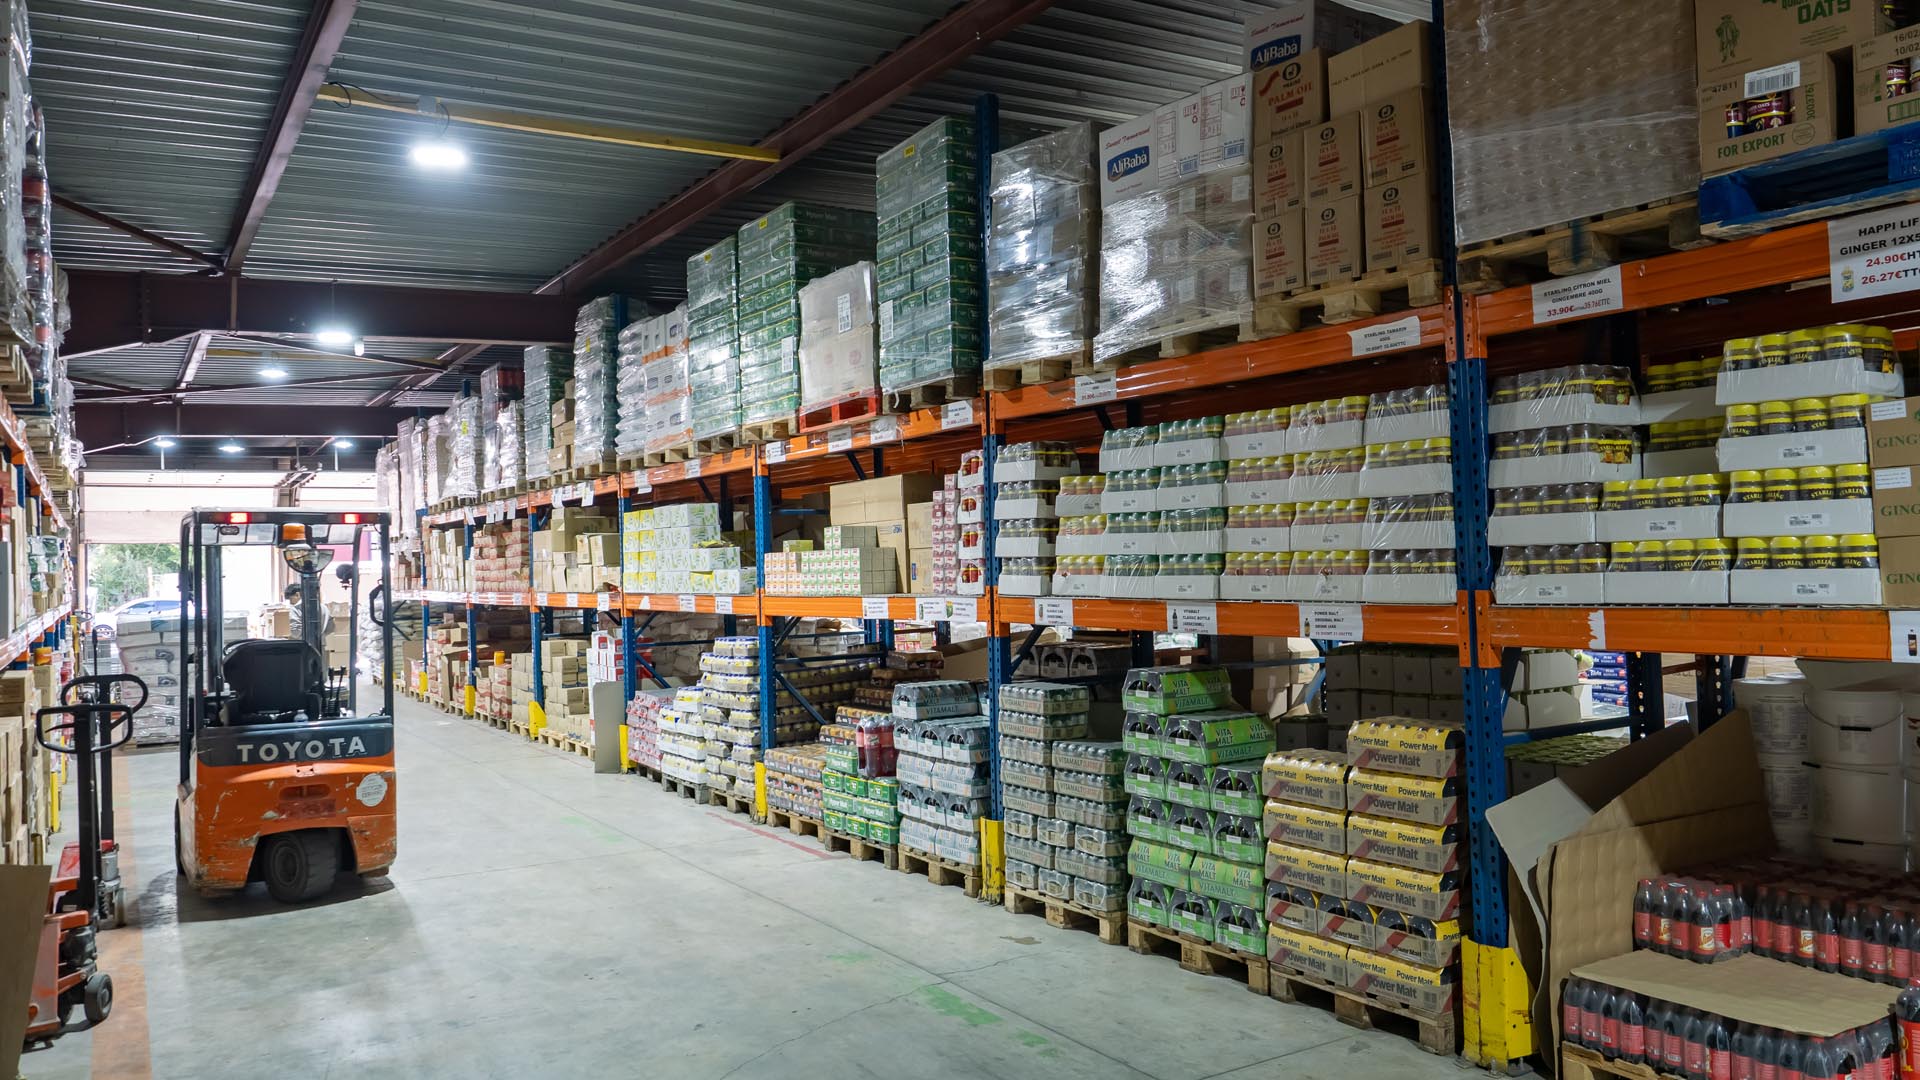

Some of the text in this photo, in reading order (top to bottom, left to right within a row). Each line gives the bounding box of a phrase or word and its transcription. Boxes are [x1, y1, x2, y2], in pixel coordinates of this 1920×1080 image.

[1894, 29, 1920, 42] 16/02
[1255, 42, 1297, 64] AliBaba
[1718, 133, 1785, 158] FOR EXPORT
[1111, 151, 1147, 175] AliBaba
[1858, 222, 1896, 237] HAPPI
[1840, 239, 1887, 255] GINGER
[1862, 268, 1920, 284] 26.27€TT
[1573, 281, 1596, 292] CITRON
[1596, 278, 1612, 286] MIEL
[1546, 305, 1575, 317] 33.90€
[1876, 434, 1920, 449] GING
[1172, 680, 1189, 688] VITA
[1174, 688, 1190, 697] MALT
[1216, 728, 1232, 736] VITA
[1216, 736, 1234, 746] MALT
[1354, 736, 1389, 748] Power Malt
[1399, 740, 1438, 752] Power Malt
[236, 736, 366, 762] TOYOTA
[1216, 747, 1252, 759] VITAMALT
[1369, 750, 1421, 767] Power Malt
[1305, 773, 1324, 783] Power
[1280, 782, 1323, 798] Power Malt
[1353, 780, 1388, 792] Power Malt
[1398, 787, 1436, 798] Power Malt
[1368, 796, 1419, 814] Power Malt
[1306, 817, 1338, 828] Power Malt
[1280, 824, 1324, 842] Power Malt
[1353, 825, 1388, 838] Power Malt
[1398, 832, 1435, 846] Power Malt
[1368, 840, 1418, 860] Power Malt
[1307, 860, 1339, 872] Power Malt
[1237, 868, 1251, 879] VITA
[1281, 865, 1325, 886] Power Malt
[1352, 870, 1386, 884] Power Malt
[1232, 878, 1251, 888] MALT
[1396, 879, 1432, 893] Power Malt
[1366, 887, 1416, 907] Power Malt
[1308, 945, 1340, 960] Power Malt
[1283, 950, 1326, 972] Power Malt
[1352, 958, 1386, 975] Power Malt
[1396, 970, 1433, 985] Power Malt
[1367, 975, 1417, 999] Power Malt
